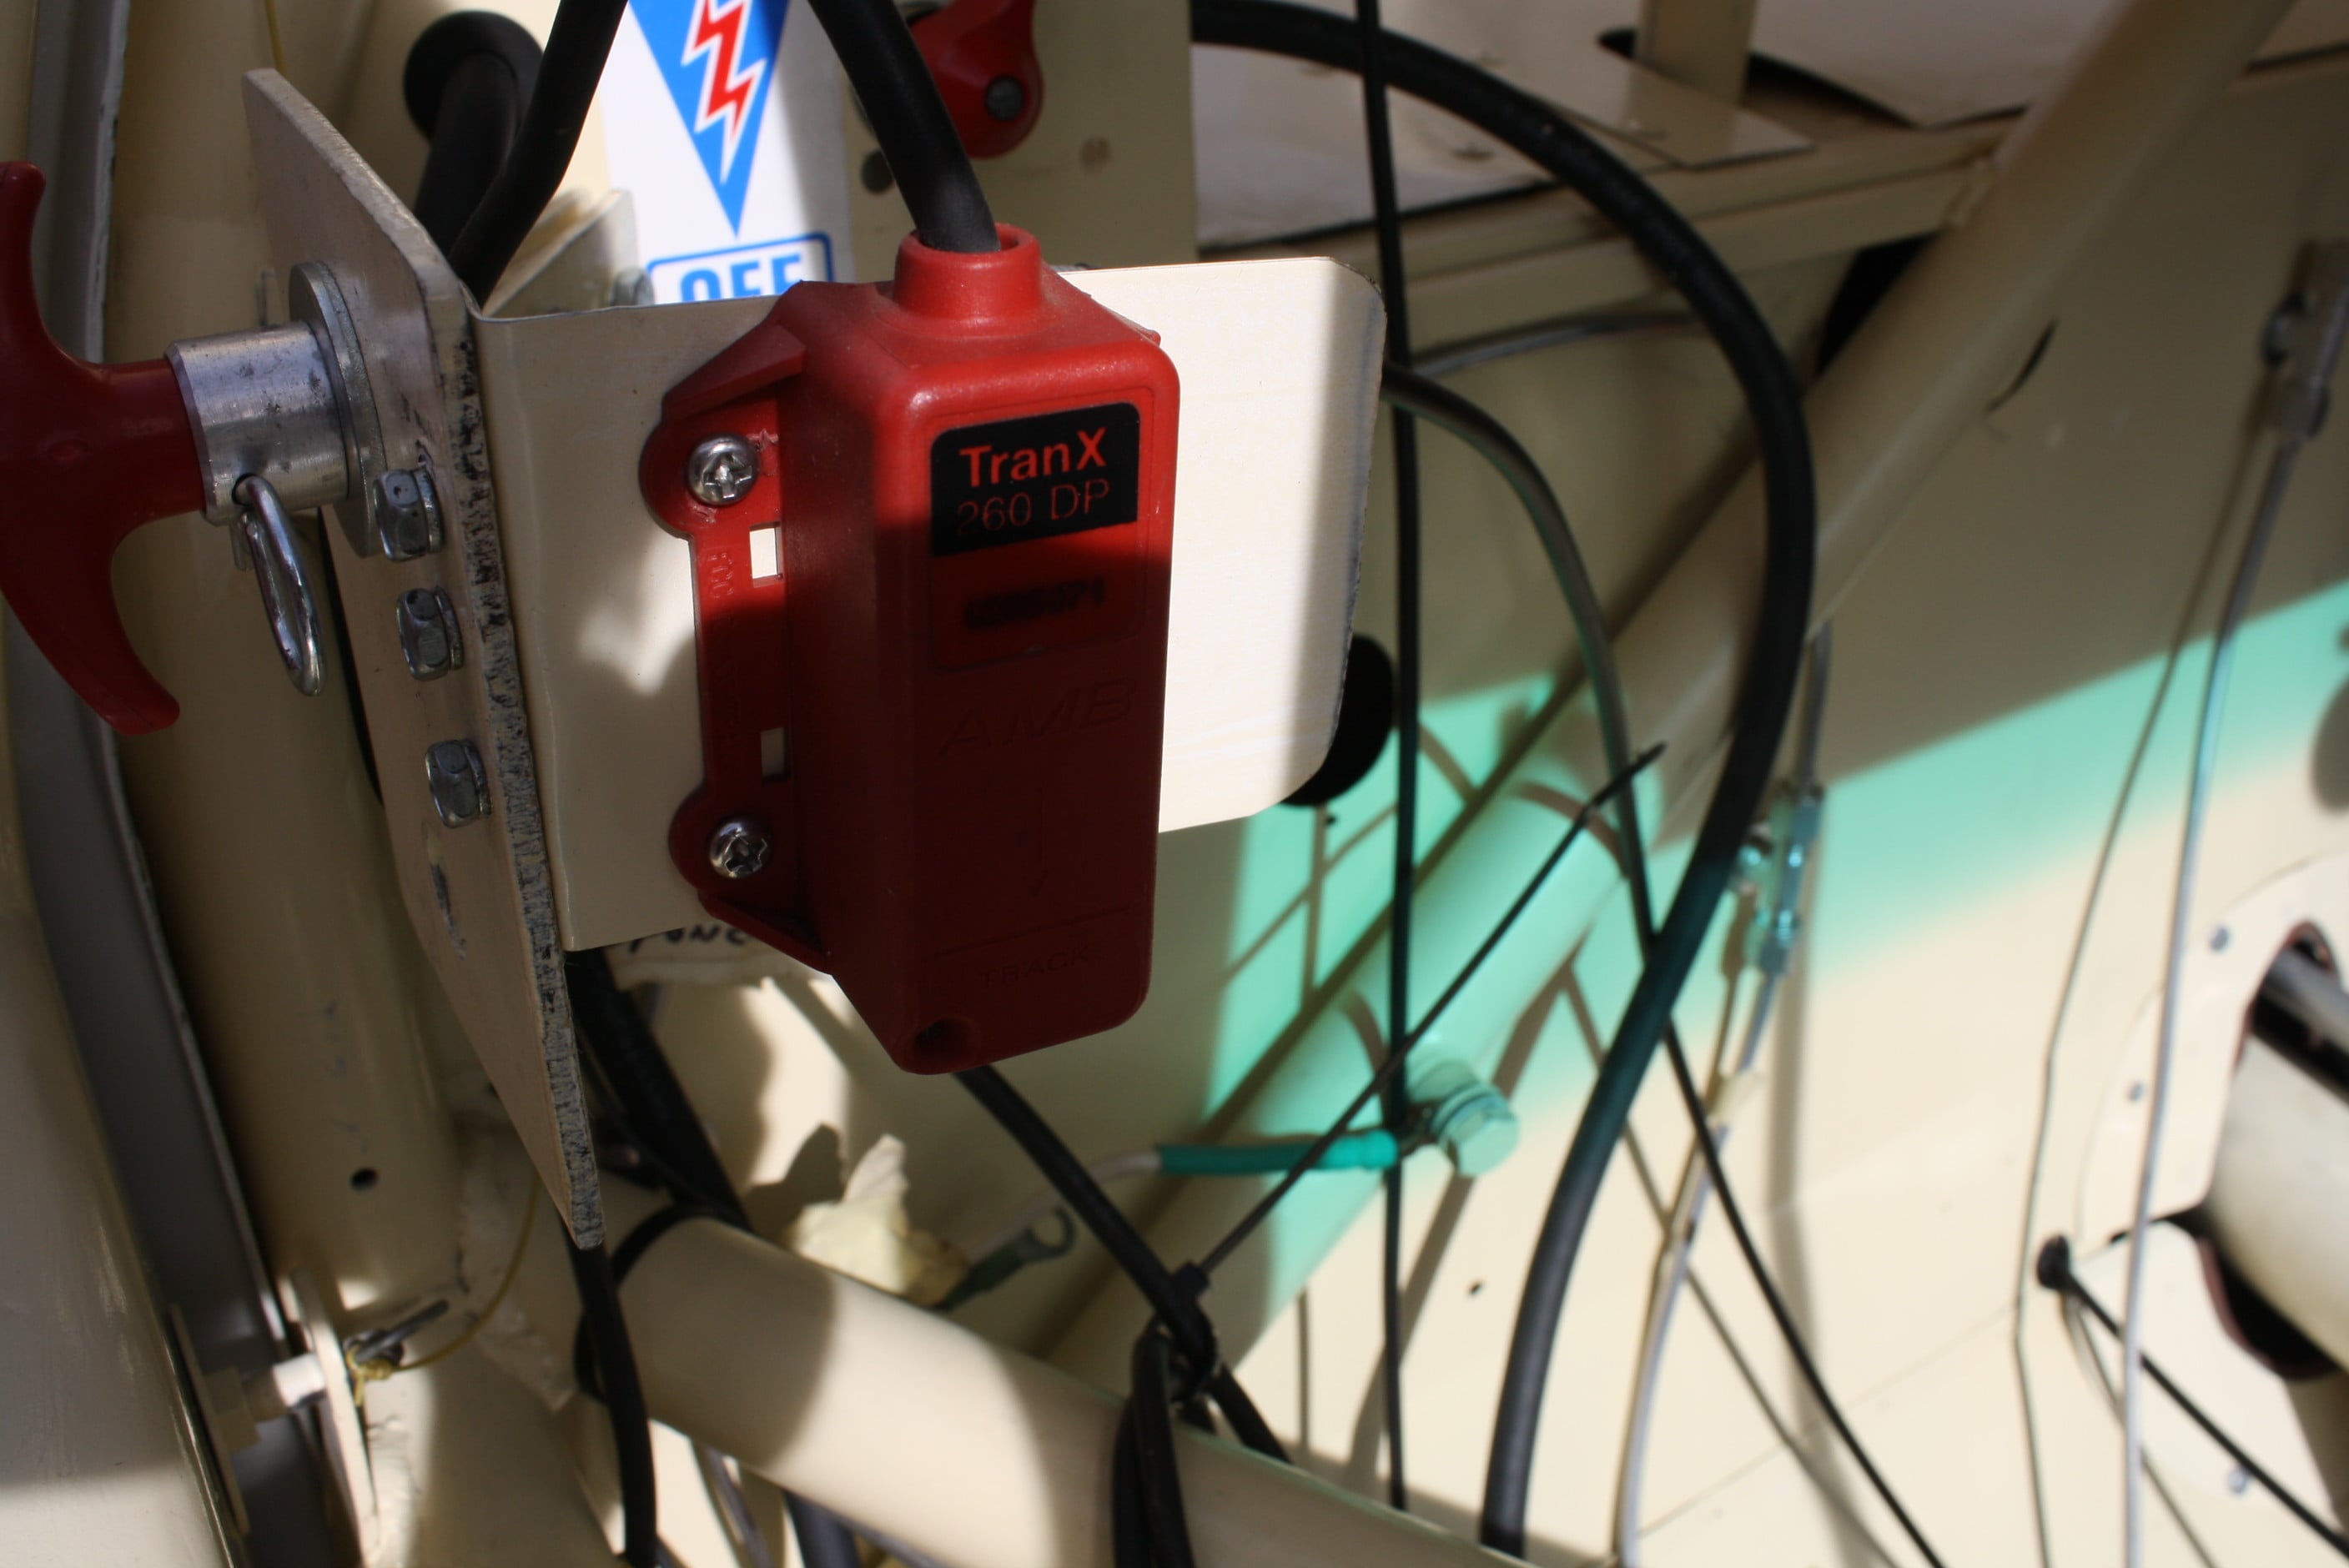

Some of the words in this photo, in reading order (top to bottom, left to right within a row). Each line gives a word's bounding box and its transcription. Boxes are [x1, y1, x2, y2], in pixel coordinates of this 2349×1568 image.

[958, 426, 1108, 488] TranX
[955, 490, 1034, 539] 260
[1049, 477, 1111, 520] DP
[933, 675, 1139, 761] AMB
[978, 942, 1091, 988] TRACK
